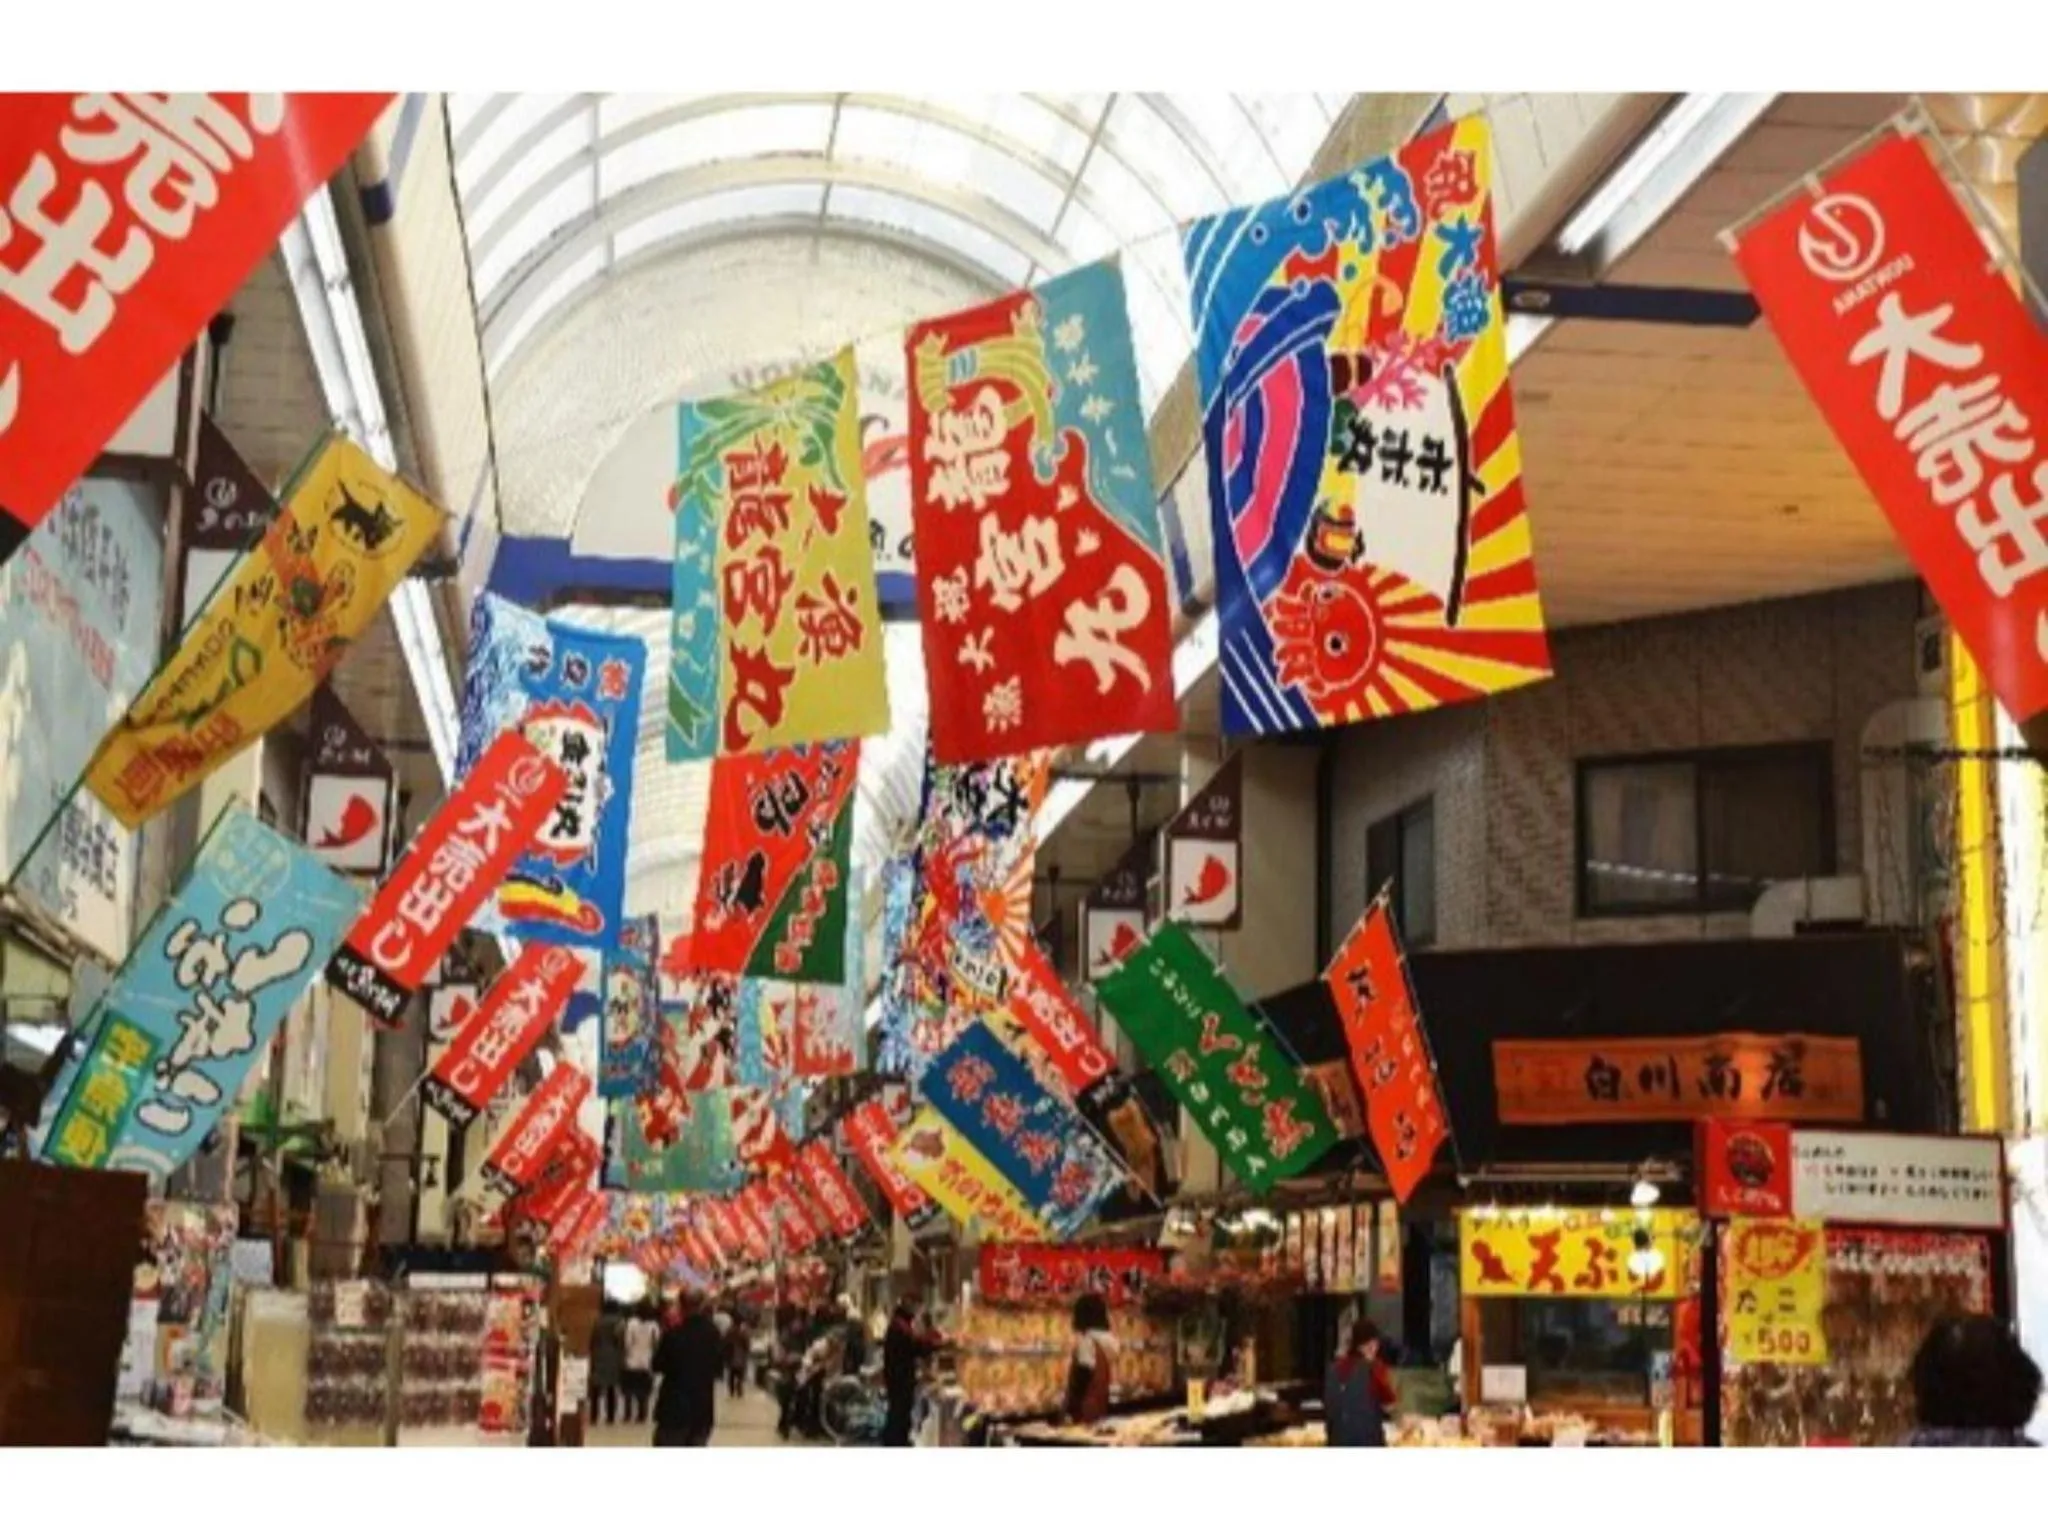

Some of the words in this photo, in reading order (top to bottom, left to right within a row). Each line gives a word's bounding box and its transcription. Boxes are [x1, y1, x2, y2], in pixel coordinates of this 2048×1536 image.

[0, 92, 285, 432] 売出
[371, 797, 516, 970] 大売出し
[450, 976, 549, 1095] 大売出し
